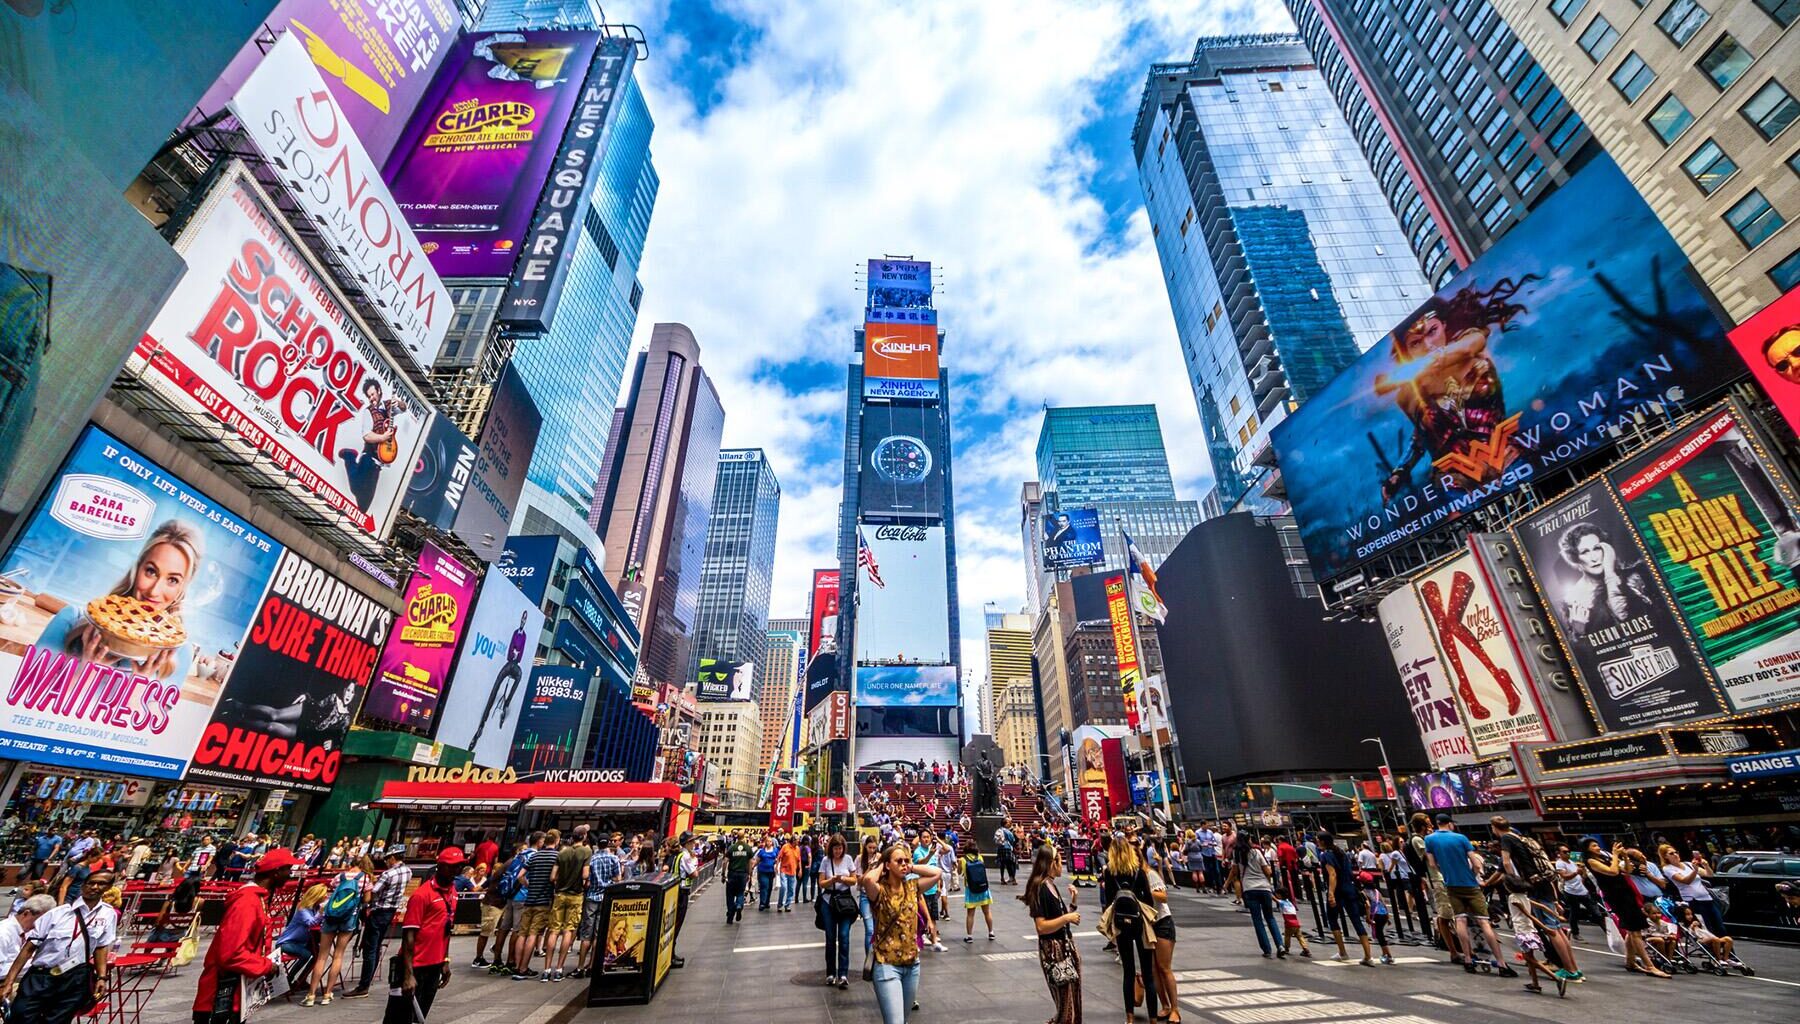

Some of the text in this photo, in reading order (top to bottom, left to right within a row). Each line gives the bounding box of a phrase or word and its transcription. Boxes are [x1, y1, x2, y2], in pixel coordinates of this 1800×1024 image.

[356, 20, 394, 75] CORNER
[369, 26, 406, 78] AROUND
[362, 42, 397, 89] STREET
[438, 102, 532, 132] CHARLIE
[439, 132, 491, 145] CHOCOLATE
[494, 131, 533, 142] FACTORY
[478, 143, 517, 151] MUSICAL
[264, 108, 331, 206] GOES
[523, 56, 622, 281] TIMES SQUARE
[296, 87, 438, 331] WRONG
[450, 203, 499, 211] SEMI-SWEET
[329, 206, 370, 266] THAT
[882, 272, 918, 281] NEW YORK
[895, 264, 919, 273] PGIM
[231, 189, 283, 249] ANDREW
[277, 240, 310, 283] LLOYD
[309, 278, 343, 326] WEBBER
[340, 318, 358, 345] HAS
[356, 335, 395, 387] BROADWAY
[368, 262, 407, 321] PLAY
[513, 298, 537, 306] NYC
[228, 238, 366, 409] SCHOOL
[404, 308, 428, 349] THE
[872, 311, 930, 321] 新华通讯社
[281, 343, 317, 378] of
[880, 342, 932, 352] XINHUA
[187, 279, 355, 467] ROCK
[880, 380, 925, 391] XINHUA
[870, 388, 935, 398] NEWS AGENCY
[253, 404, 284, 430] MUSICAL
[493, 413, 508, 438] YOU
[1103, 413, 1150, 424] BARCLAYS
[194, 383, 369, 528] JUST 4 BLOCKS TO THE WINTER GARDEN THEATRE
[489, 425, 513, 465] TO THE
[719, 453, 743, 461] Allianz
[1346, 353, 1675, 542] WONDER WOMAN
[1620, 487, 1633, 497] The
[1632, 476, 1648, 493] New
[1644, 466, 1663, 483] York
[1659, 453, 1682, 471] Times
[1711, 413, 1734, 435] PICK
[477, 457, 490, 475] OF
[483, 443, 509, 481] POWER
[1356, 520, 1422, 559] EXPERIENCE
[1420, 514, 1435, 532] IT
[1434, 506, 1449, 524] IN
[1449, 480, 1501, 512] IMAX
[1502, 463, 1535, 489] 3D
[1541, 433, 1589, 468] NOW
[1596, 386, 1685, 439] PLAYING
[444, 445, 476, 511] NEW
[1670, 471, 1699, 503] A
[92, 494, 124, 512] SARA
[102, 445, 272, 553] IF ONLY LIFE WERE AS EASY AS PIE
[471, 472, 510, 525] EXPERTISE.
[69, 501, 136, 528] BAREILLES
[1538, 500, 1591, 537] TRIUMPH!
[1647, 493, 1762, 563] BRONX
[1043, 541, 1102, 557] PHANTOM
[1074, 550, 1097, 558] OPERA
[352, 552, 381, 579] OUTFRONT
[1689, 542, 1781, 611] TALE
[272, 551, 392, 647] BROADWAY'S
[410, 596, 456, 622] CHARLIE
[1117, 597, 1136, 664] BLOCKBUSTER!
[1492, 542, 1569, 691] PALACE
[1588, 614, 1654, 647] GLENN CLOSE
[1702, 609, 1750, 639] BROADWAY'S
[1748, 602, 1765, 621] NEW
[252, 597, 324, 664] SURE
[314, 626, 378, 689] THING
[472, 632, 497, 660] you
[1476, 620, 1504, 644] Boots
[1596, 646, 1617, 655] ANDREW
[1617, 641, 1633, 649] LLOYD
[536, 676, 574, 689] Nikkei
[866, 682, 942, 690] UNDER ONE NAMEPLATE
[1608, 655, 1659, 692] SUNSET
[1724, 674, 1755, 688] JERSEY
[1756, 668, 1780, 681] BOYS
[1781, 666, 1790, 675] &
[6, 644, 181, 735] WAITRESS
[535, 686, 584, 701] 19883.52
[835, 693, 847, 737] HELLO!
[1620, 713, 1641, 722] STRICTLY
[1642, 709, 1662, 718] LIMITED
[1662, 701, 1700, 713] ENGAGEMENT
[12, 714, 150, 748] THE HIT BROADWAY MUSICAL
[1472, 722, 1495, 735] WINNER!
[1500, 718, 1516, 730] TONY
[1500, 729, 1516, 737] BEST
[12, 739, 49, 753] THEATRE
[52, 745, 65, 755] 256
[194, 722, 343, 785] CHICAGO
[1430, 736, 1471, 760] NETFLIX
[1580, 751, 1599, 760] never
[1599, 747, 1613, 757] said
[1705, 736, 1738, 753] SUNSET
[189, 767, 253, 782] CHICAGOTHEMUSICAL.COM
[407, 761, 518, 783] nuchas
[544, 769, 625, 783] NYC HOTDOGS
[1730, 756, 1795, 774] CHANGE
[36, 776, 127, 804] GRAND
[164, 788, 219, 812] SLAM
[776, 786, 790, 817] tkts
[1086, 790, 1102, 821] tkts
[612, 901, 649, 912] Beautiful
